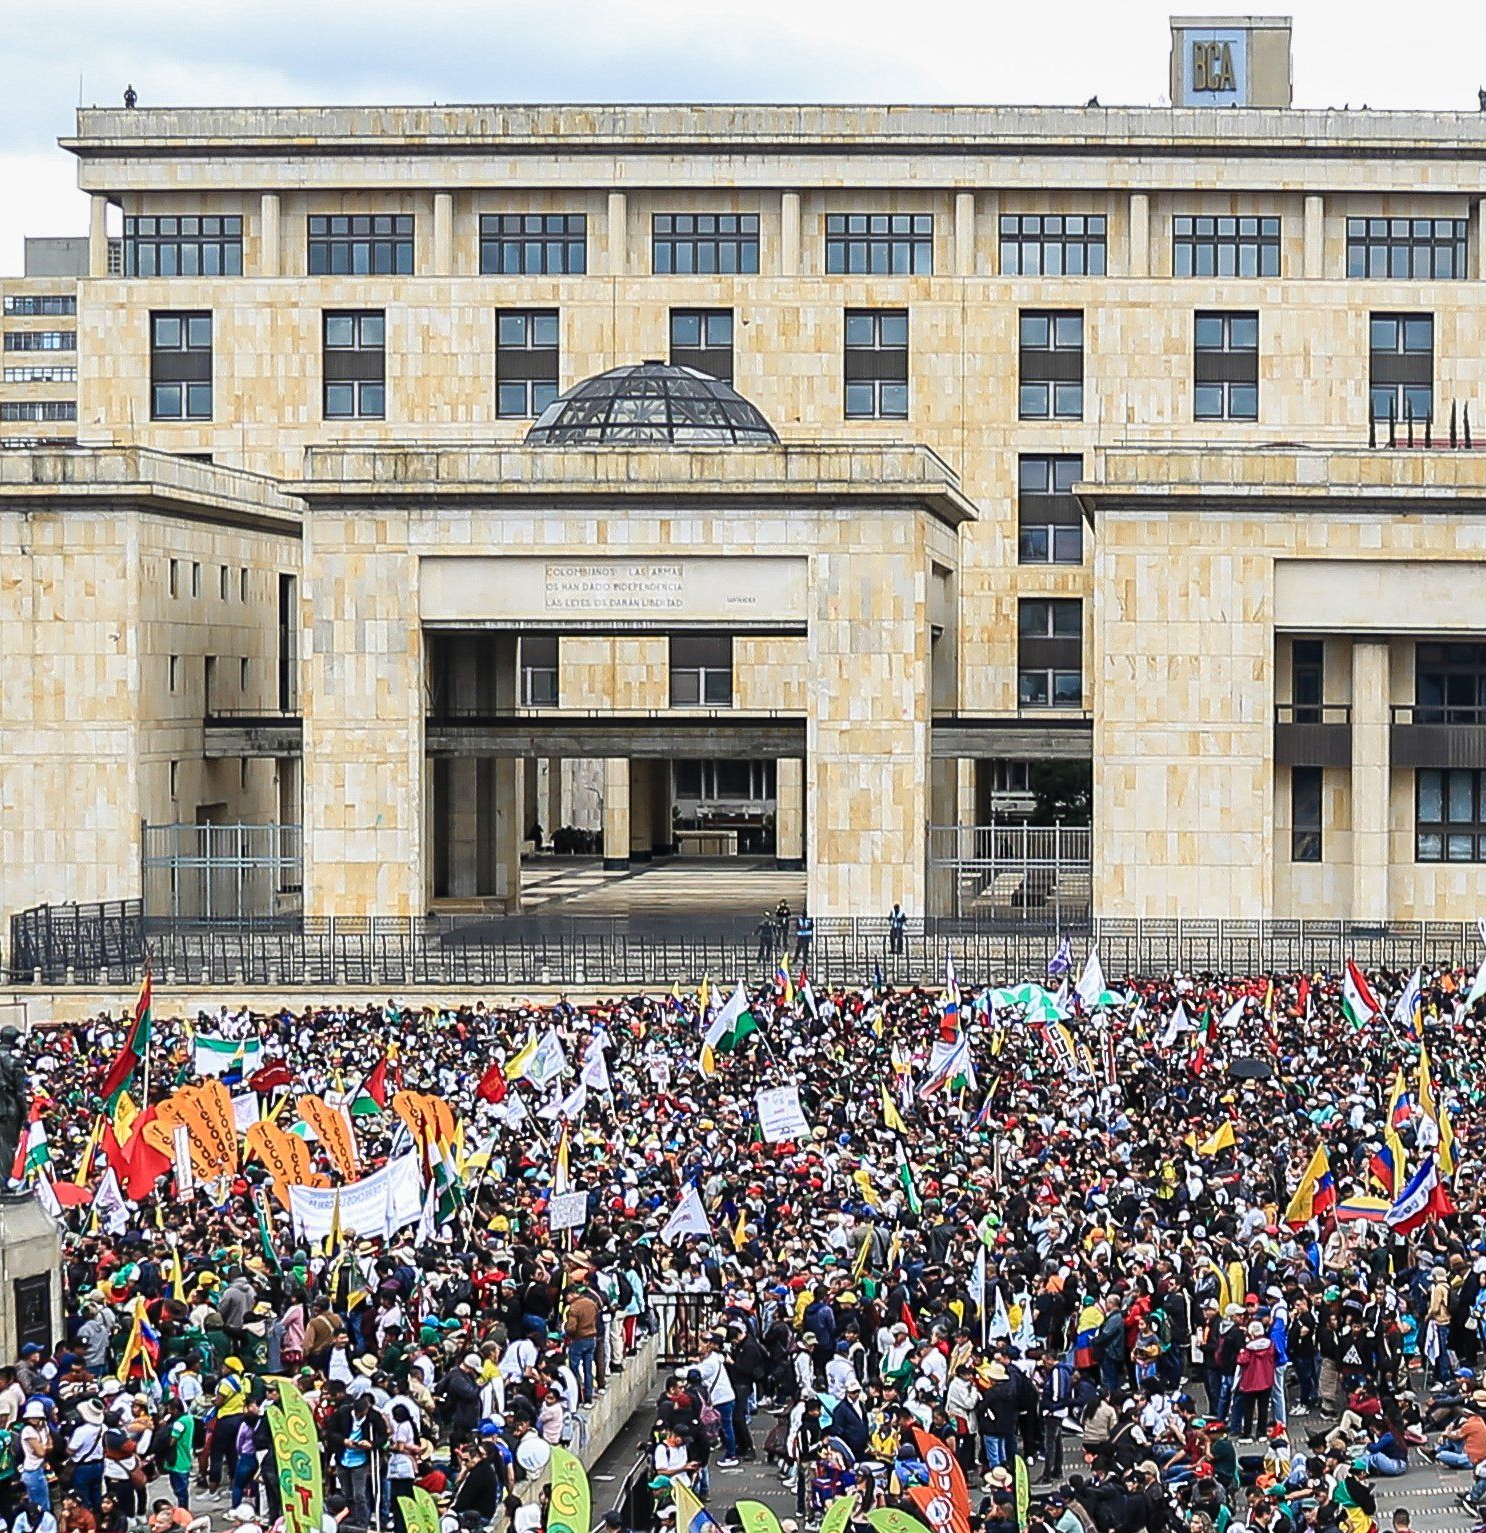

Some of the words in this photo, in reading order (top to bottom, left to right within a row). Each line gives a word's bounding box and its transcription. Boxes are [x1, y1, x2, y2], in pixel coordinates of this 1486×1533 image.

[1192, 41, 1236, 91] BCA
[1048, 1026, 1074, 1069] CUT
[285, 1413, 314, 1517] CGT
